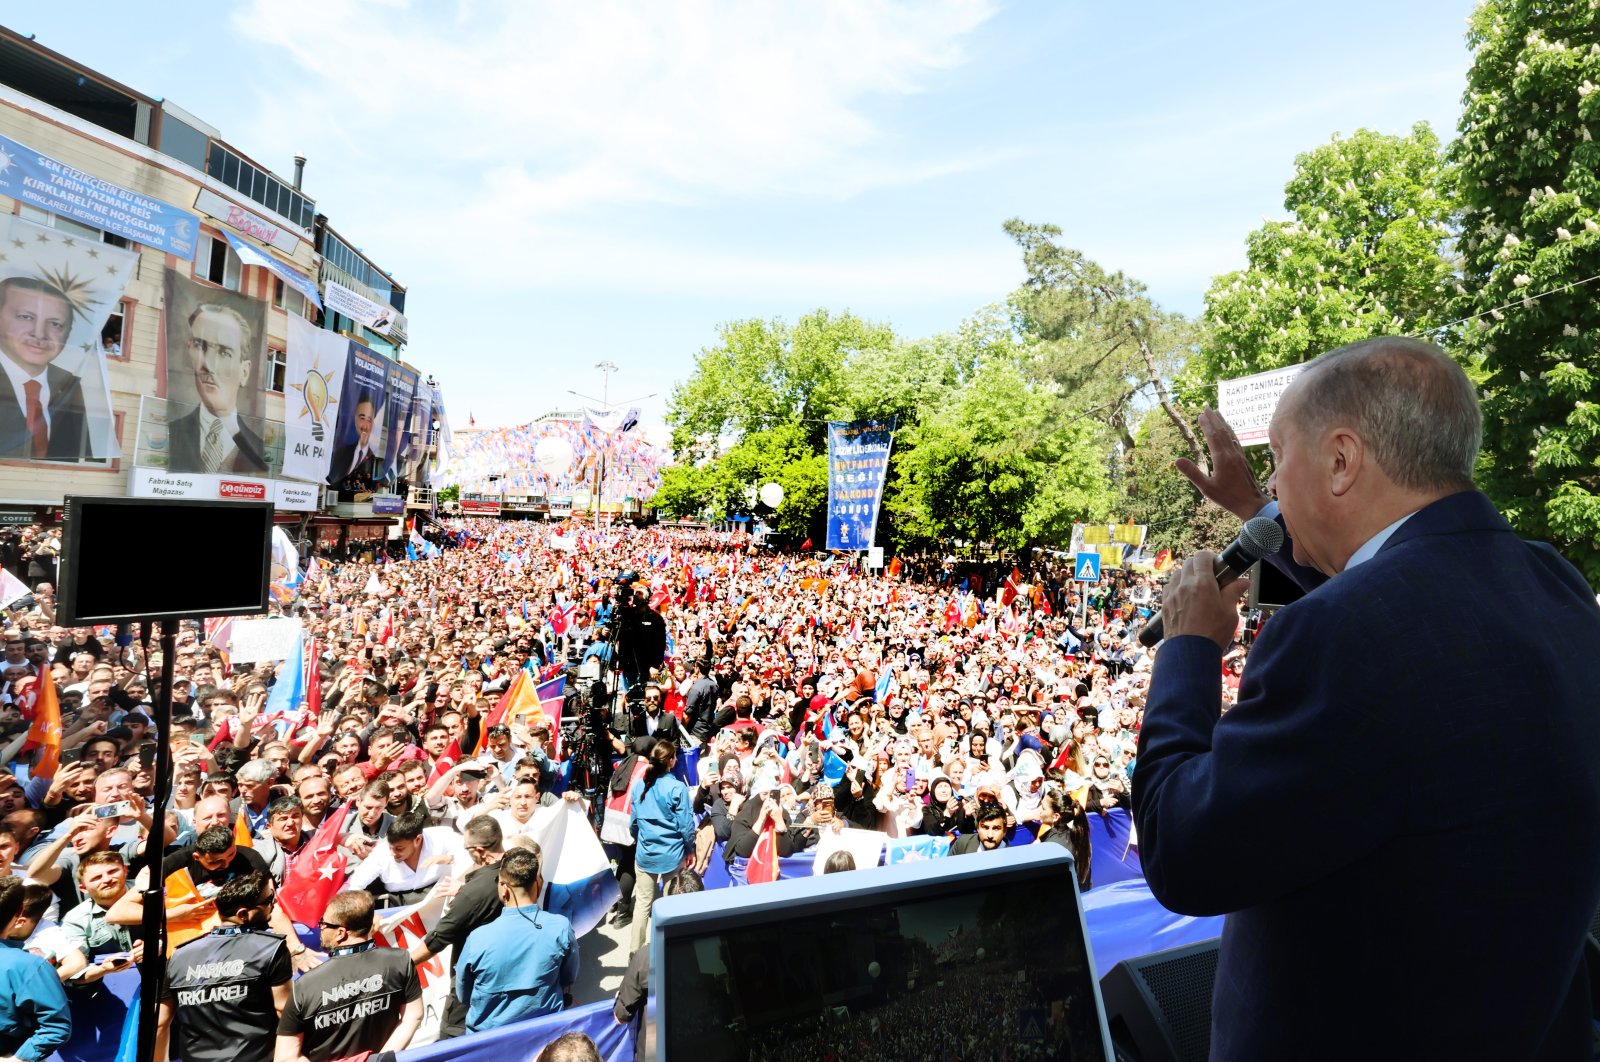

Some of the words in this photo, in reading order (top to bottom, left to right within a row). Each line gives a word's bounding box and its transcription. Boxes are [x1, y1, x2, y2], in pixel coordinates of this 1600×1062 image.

[37, 156, 61, 174] SEN
[119, 188, 133, 202] BU
[134, 194, 163, 214] NASIL
[50, 173, 83, 193] TARİH
[85, 185, 129, 212] YAZMAK
[130, 204, 152, 220] REİS
[73, 208, 105, 225] MERKEZ
[109, 209, 166, 236] HOŞGELDİN
[1250, 376, 1284, 391] TANIMAZ
[1236, 391, 1272, 405] MUHARREM
[294, 442, 308, 457] AK
[148, 477, 175, 486] Fabrika
[176, 478, 193, 488] Satış
[152, 487, 184, 496] Mağazası
[282, 488, 301, 496] Fabrika
[321, 974, 384, 1006] NARKO
[314, 994, 390, 1030] KIRKLARELİ
